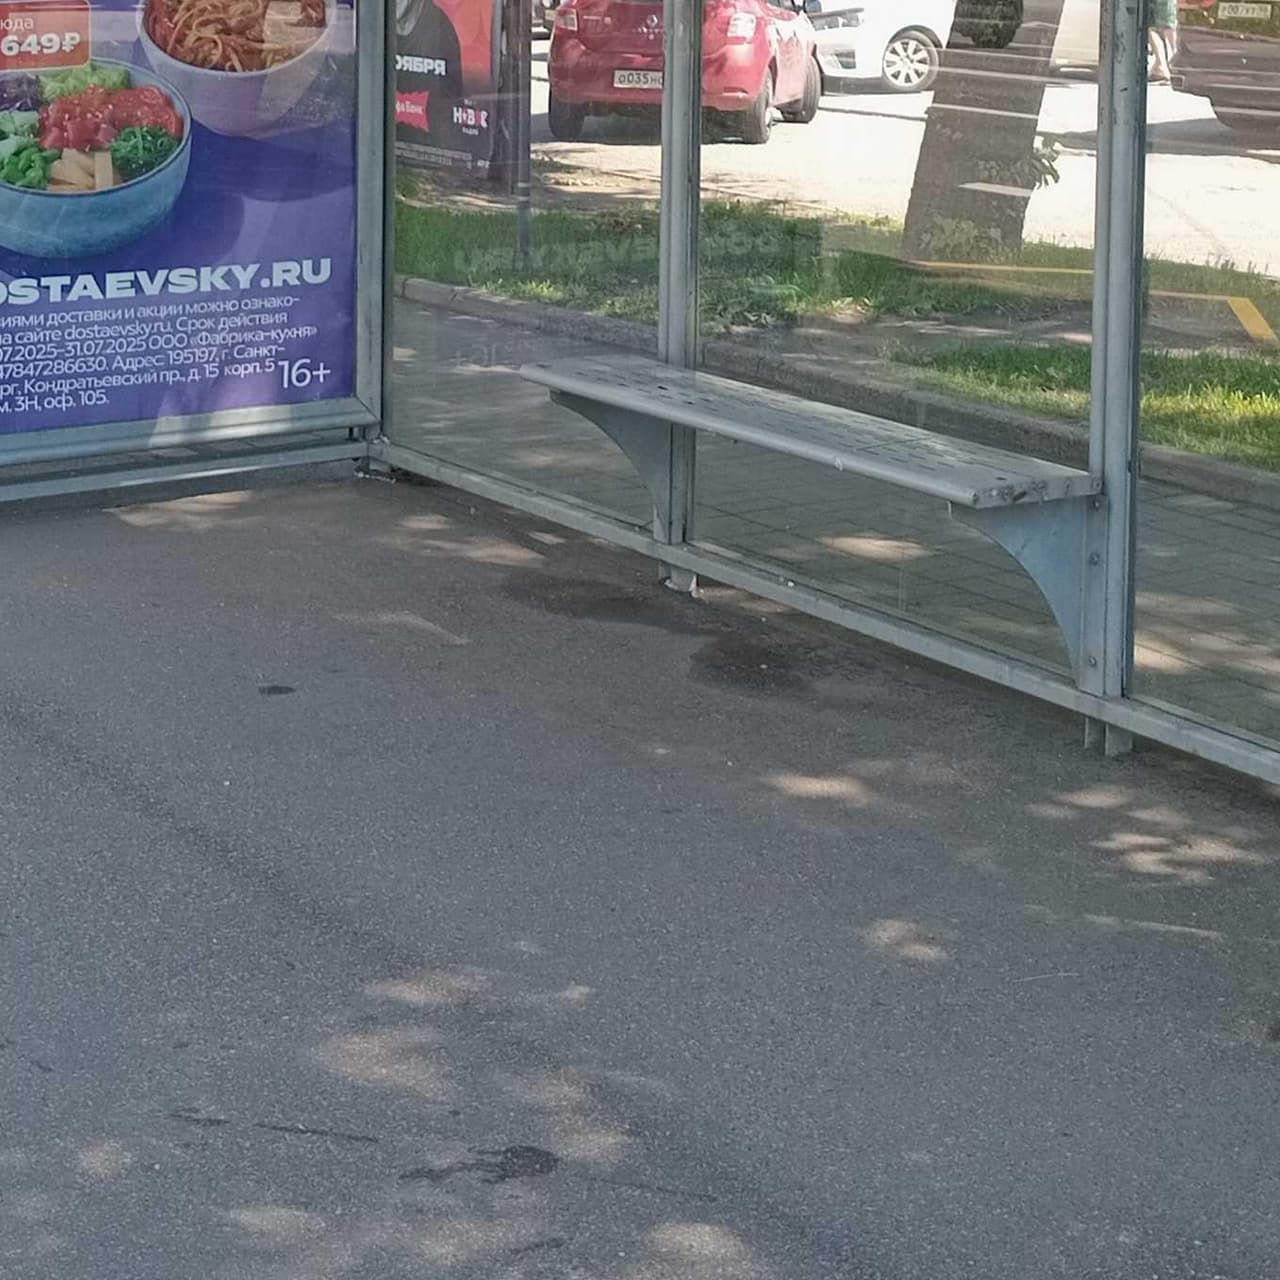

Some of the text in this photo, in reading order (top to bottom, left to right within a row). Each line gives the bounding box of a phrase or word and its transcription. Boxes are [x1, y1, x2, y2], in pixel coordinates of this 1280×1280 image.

[46, 308, 121, 327] доставки
[124, 308, 135, 319] и
[137, 304, 183, 319] акции
[185, 299, 239, 314] можно
[241, 296, 300, 311] ознако-
[15, 327, 62, 344] сайте
[176, 315, 215, 333] Срок
[218, 312, 288, 329] действия
[148, 333, 188, 350] ООО
[233, 344, 285, 359] Санкт-
[24, 369, 157, 394] Кондратьевский
[224, 361, 263, 379] корп.
[264, 358, 276, 372] 5
[279, 358, 331, 389] 16+
[44, 393, 76, 412] оф.
